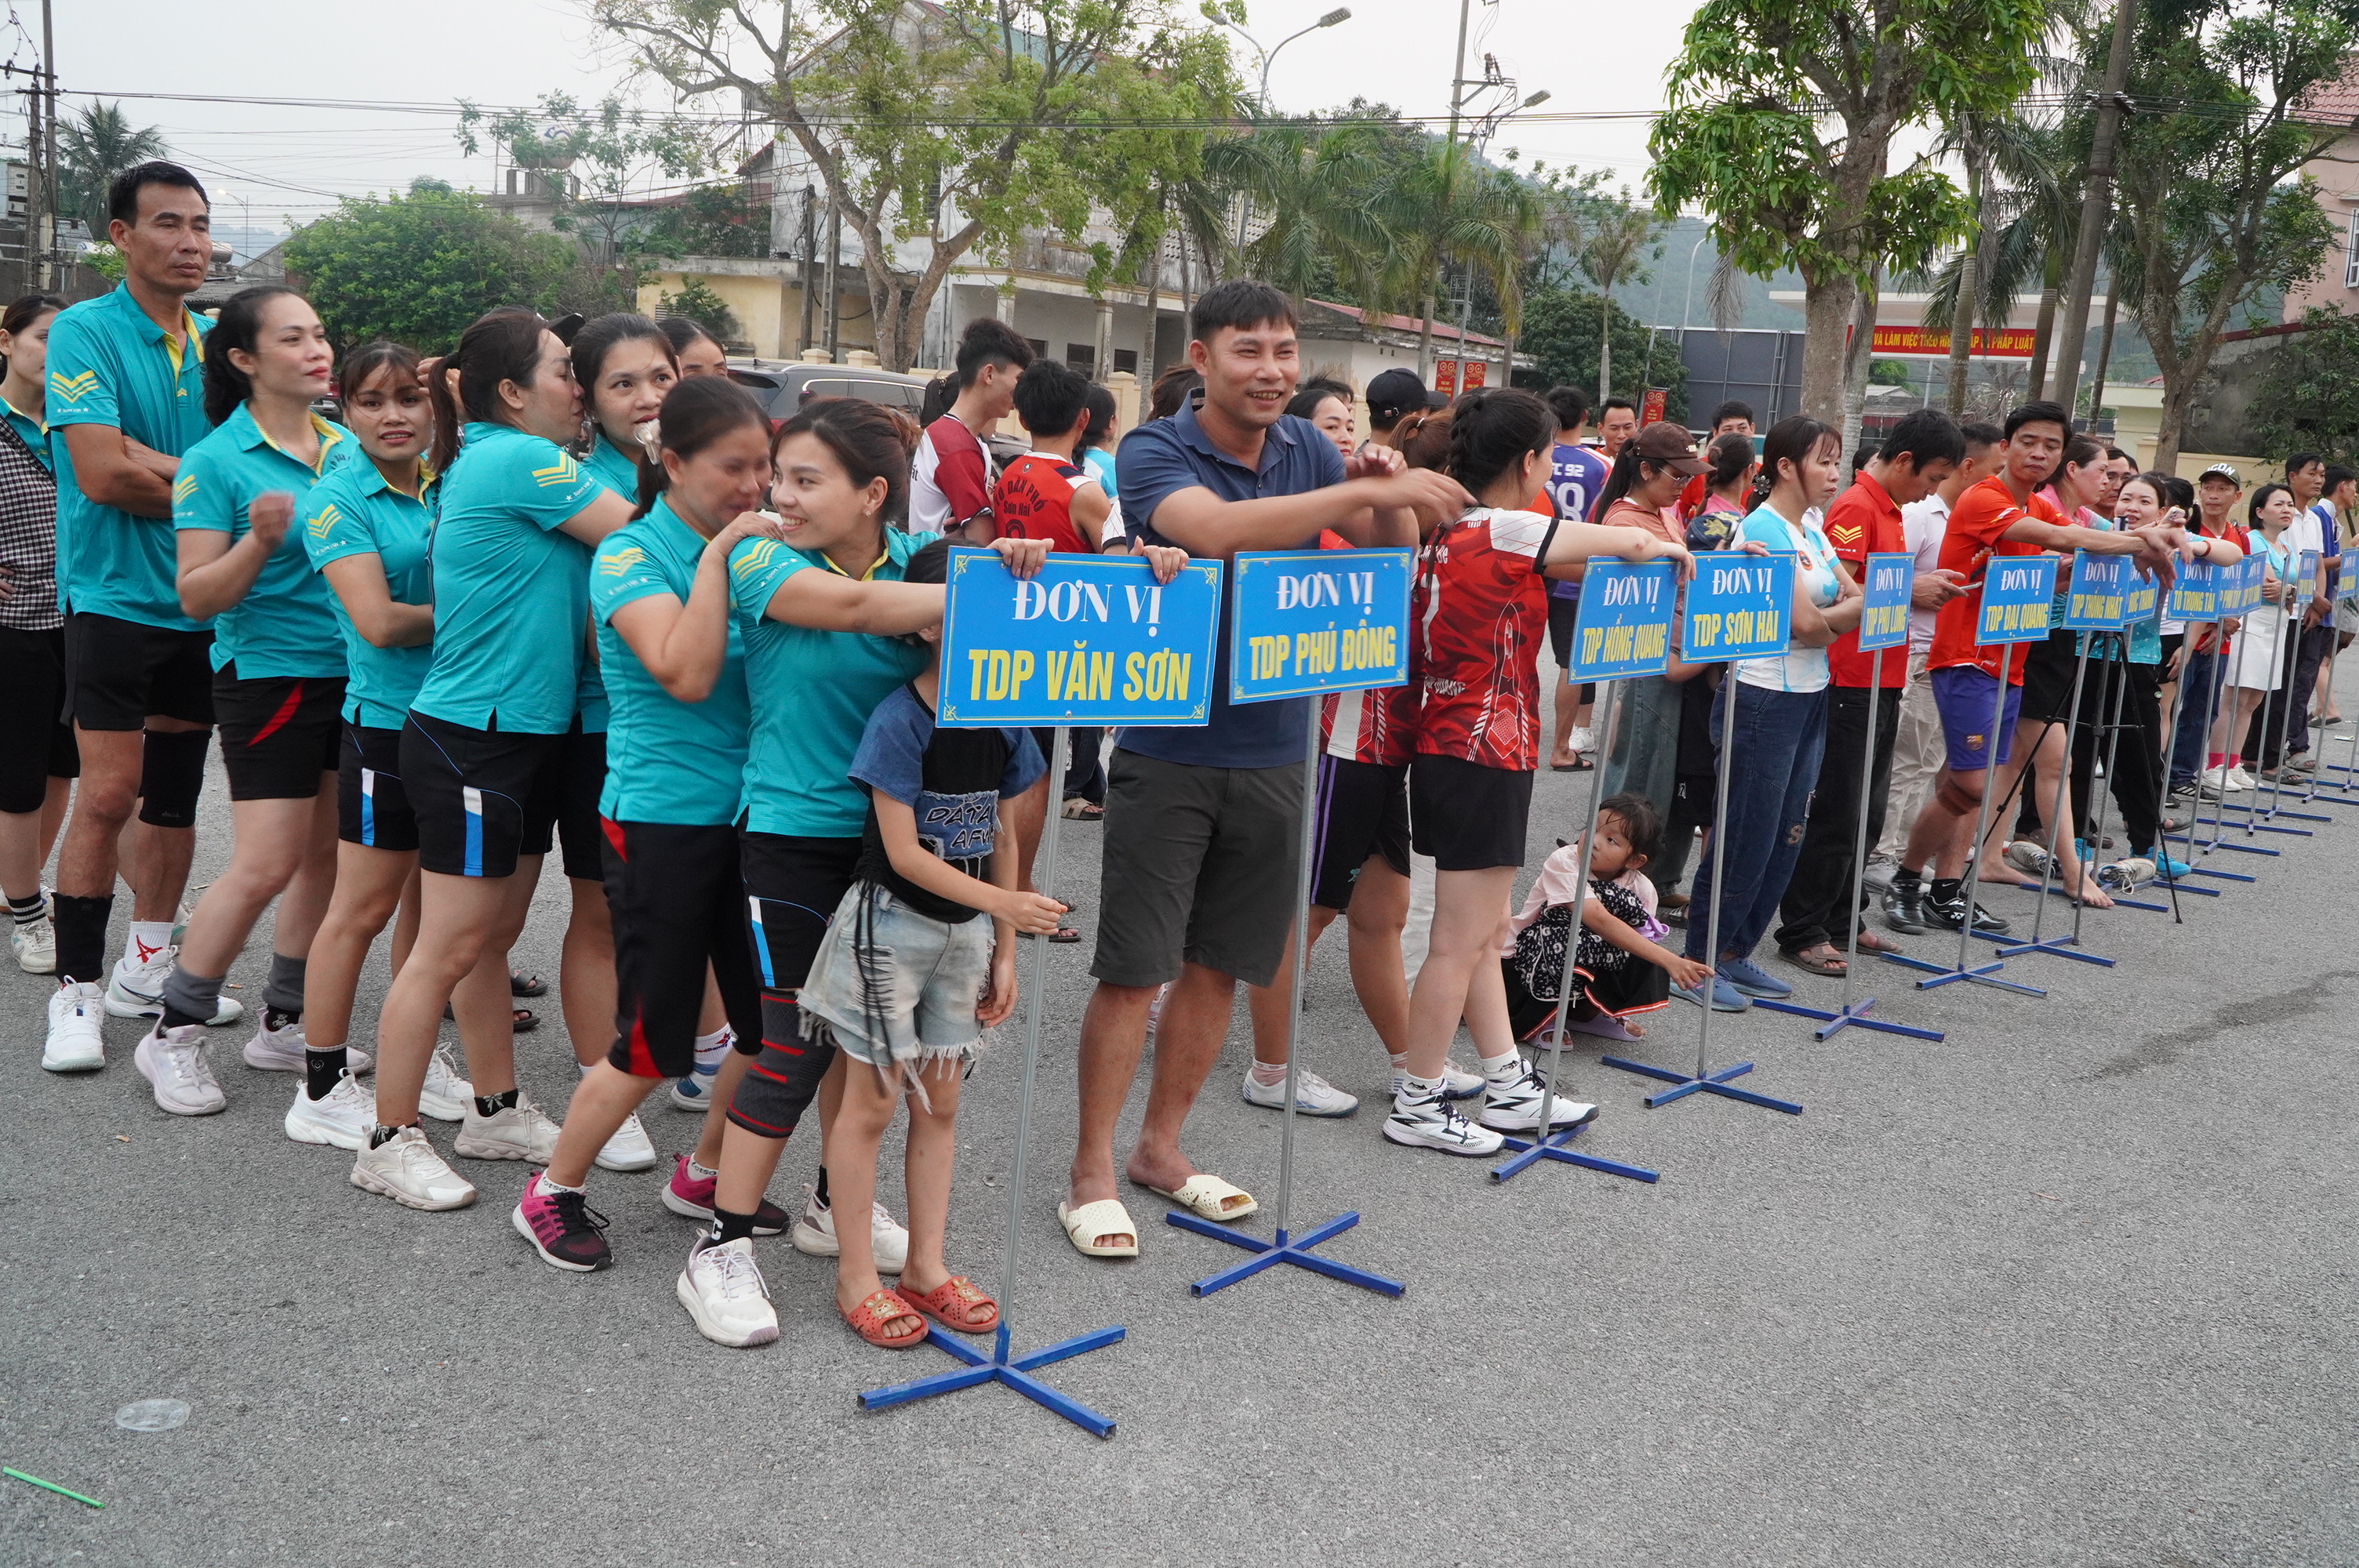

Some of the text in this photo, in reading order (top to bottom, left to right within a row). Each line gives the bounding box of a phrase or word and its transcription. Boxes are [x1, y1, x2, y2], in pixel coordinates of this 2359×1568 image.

[1874, 331, 1883, 346] VÀ
[1885, 331, 1901, 346] LÀM
[1903, 332, 1918, 349] VIỆC
[1991, 334, 2013, 349] PHÁP
[2014, 334, 2035, 352] LUẬT
[1565, 463, 1585, 477] 92
[1712, 567, 1772, 601] ĐƠN VỊ
[1875, 567, 1904, 597] ĐƠN VỊ
[2001, 568, 2042, 596] ĐƠN VỊ
[2085, 562, 2119, 589] ĐƠN VỊ
[2184, 564, 2213, 586] ĐƠN VỊ
[1012, 579, 1165, 637] ĐƠN VỊ
[1276, 572, 1375, 615] ĐƠN VỊ
[1602, 575, 1661, 613] ĐƠN VỊ
[2070, 586, 2123, 619] TDP THỐNG NHẤT
[2173, 583, 2185, 611] TỔ
[2183, 590, 2205, 616] TRỌNG
[2205, 588, 2215, 612] TÀI
[1693, 599, 1779, 647] TDP SƠN HẢI
[1865, 600, 1907, 637] TDP PHÚ LONG
[1985, 603, 2048, 636] TDP ĐẠI QUANG
[1249, 619, 1396, 681] TDP PHÚ ĐÔNG
[1580, 613, 1667, 665] TDP HỒNG QUANG
[969, 640, 1191, 701] TDP VĂN SƠN
